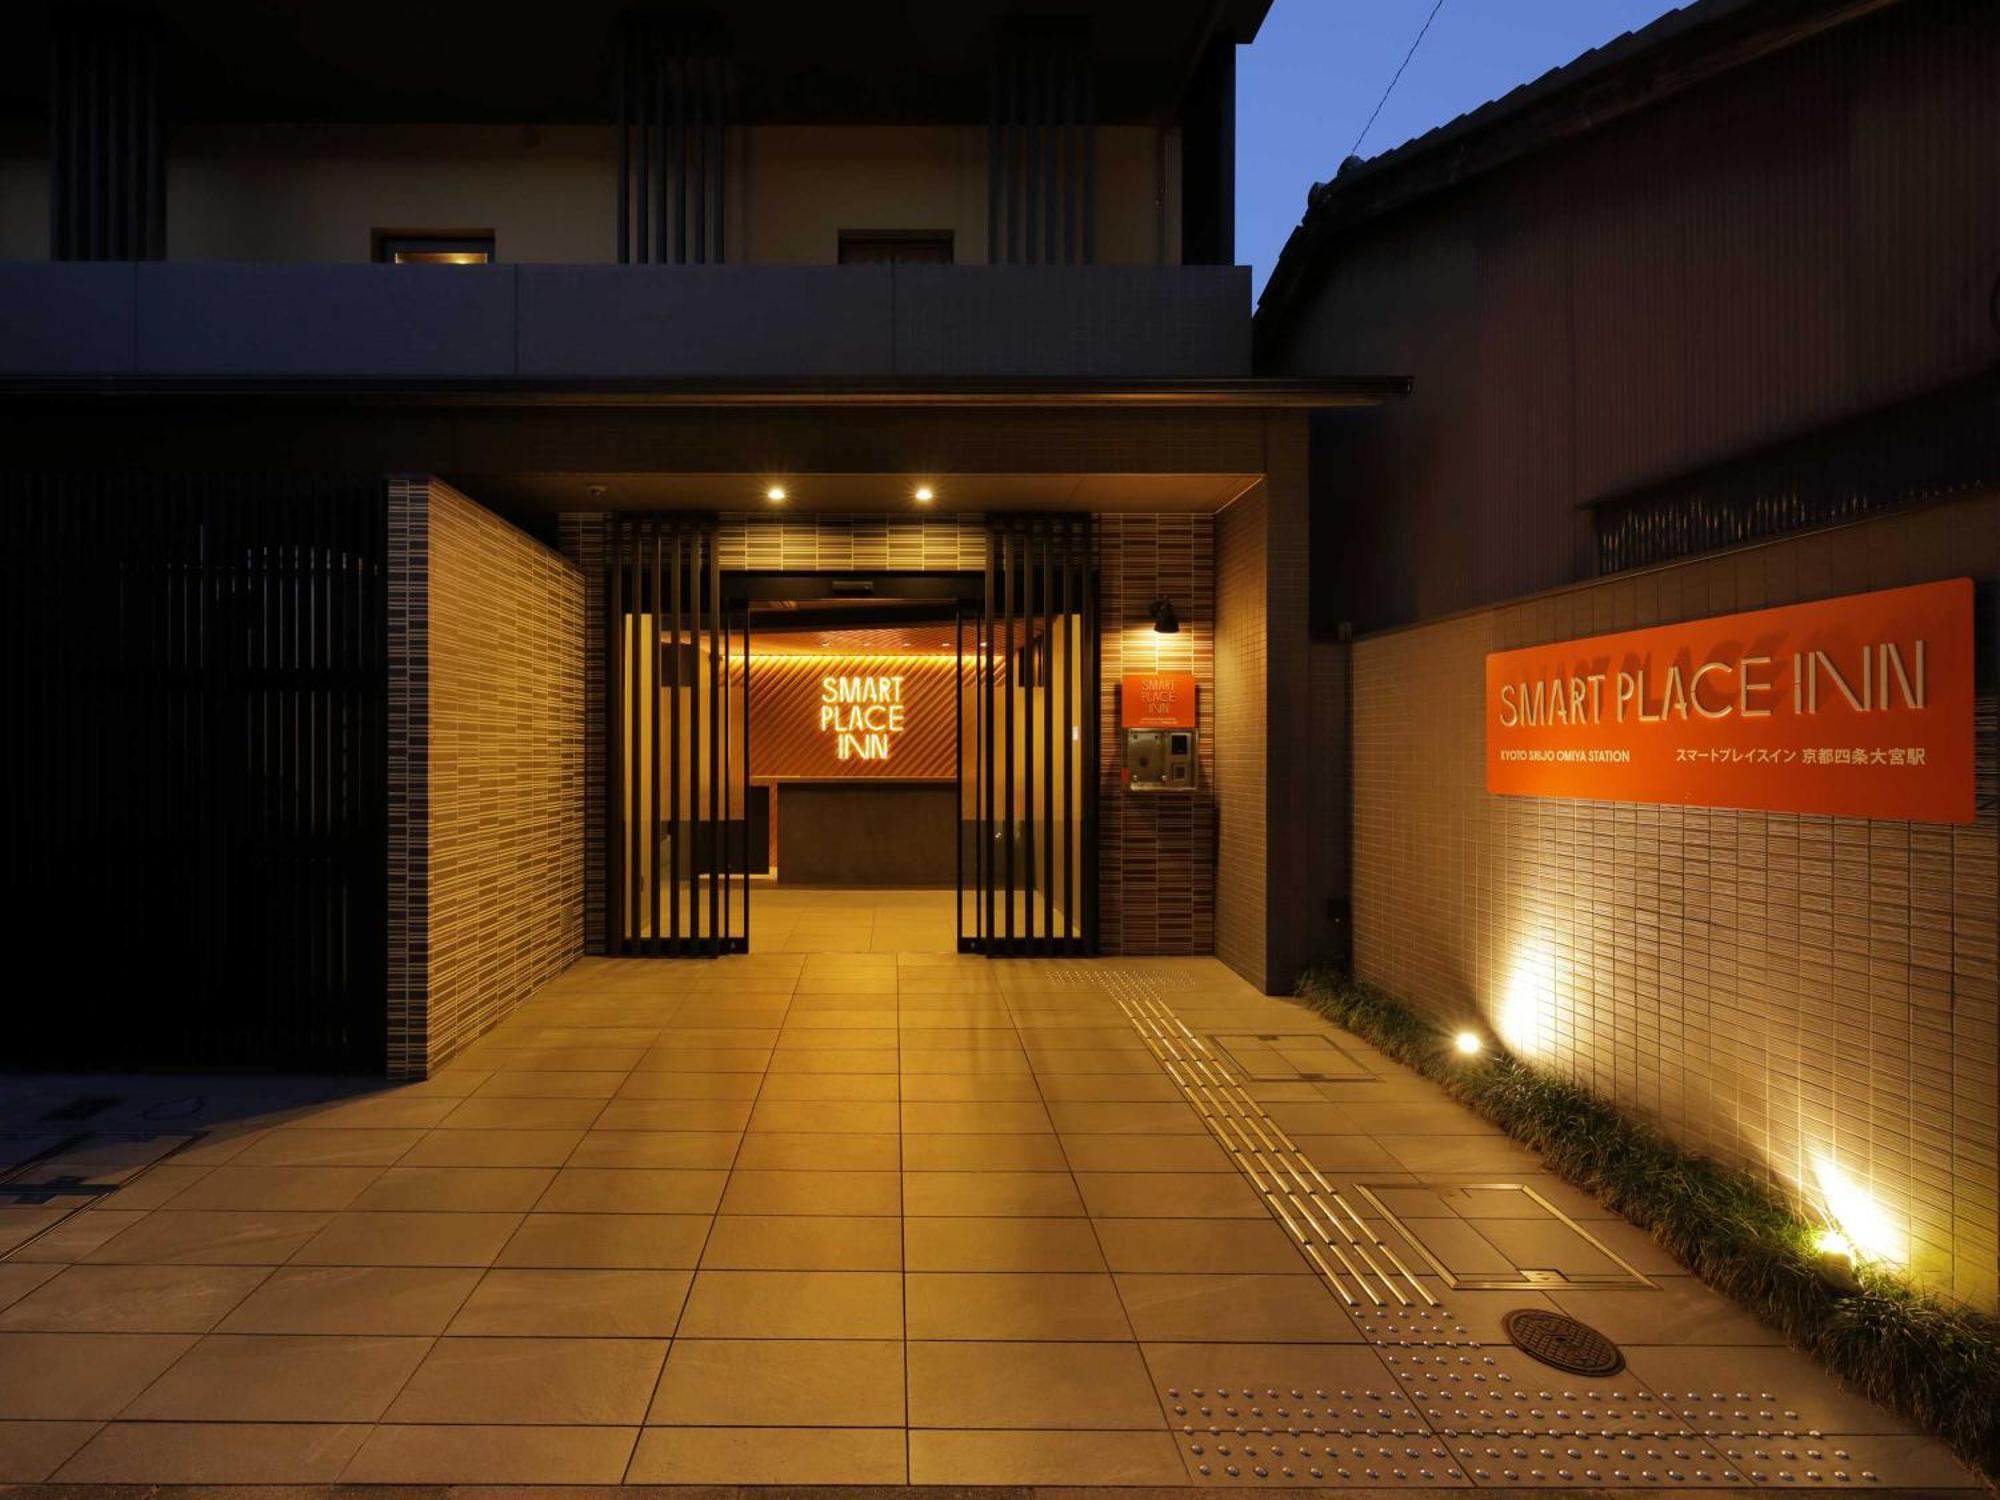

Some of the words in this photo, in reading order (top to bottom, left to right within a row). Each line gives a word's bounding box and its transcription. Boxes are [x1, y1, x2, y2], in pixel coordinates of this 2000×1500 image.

[821, 676, 904, 703] SMART
[1142, 679, 1175, 691] SMART
[1501, 672, 1605, 728] SMART
[1617, 656, 1773, 724] PLACE
[1794, 639, 1925, 715] INN
[821, 705, 904, 732] PLACE
[838, 734, 888, 760] INN
[1500, 750, 1527, 761] KYOTO
[1557, 750, 1586, 761] OMIYA
[1588, 750, 1630, 763] STATION
[1676, 748, 1796, 764] スマートプレイスイン
[1801, 747, 1926, 766] 京都四条大宮駅
